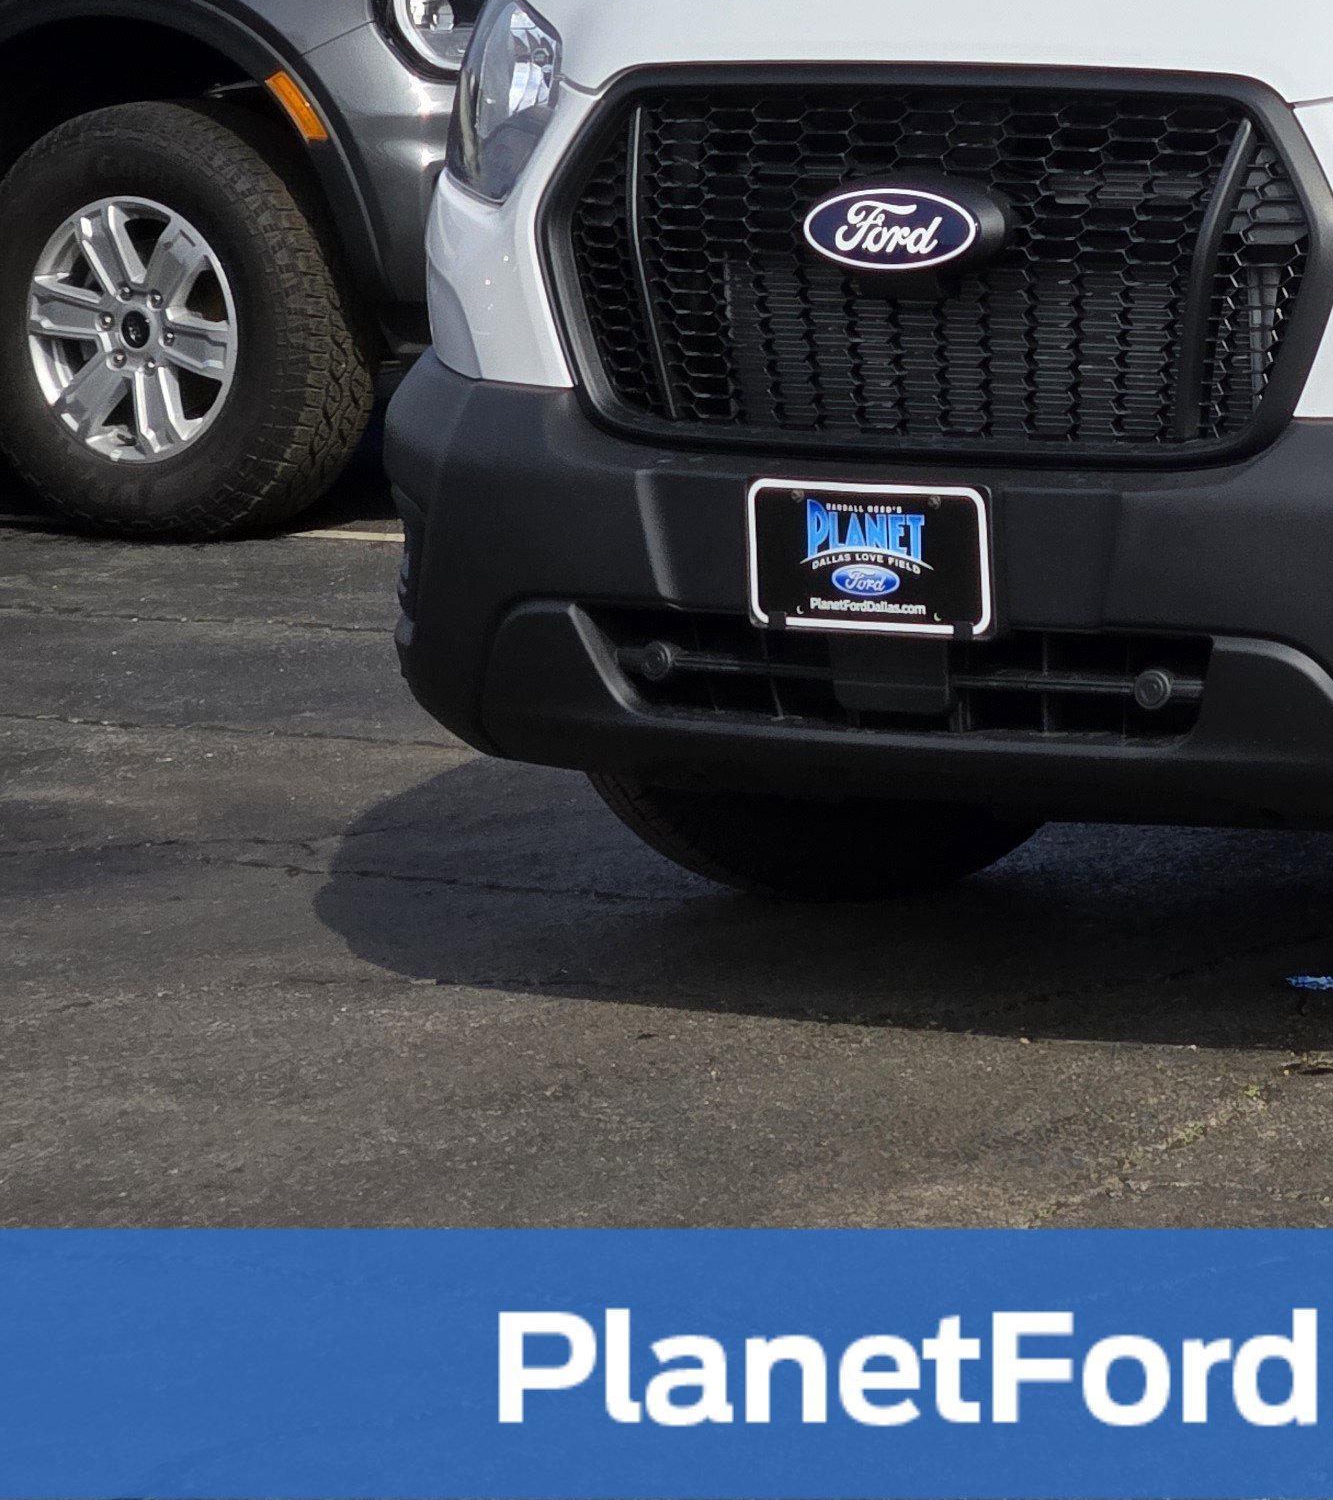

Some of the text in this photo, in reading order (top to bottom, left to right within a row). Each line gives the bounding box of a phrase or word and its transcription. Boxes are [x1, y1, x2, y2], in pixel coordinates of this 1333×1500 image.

[834, 200, 943, 254] Ford
[807, 498, 925, 561] PLANET
[811, 553, 921, 575] DALLAS LOVE FIELD
[844, 570, 887, 592] Ford
[809, 597, 927, 615] PlanetFordDallas.com
